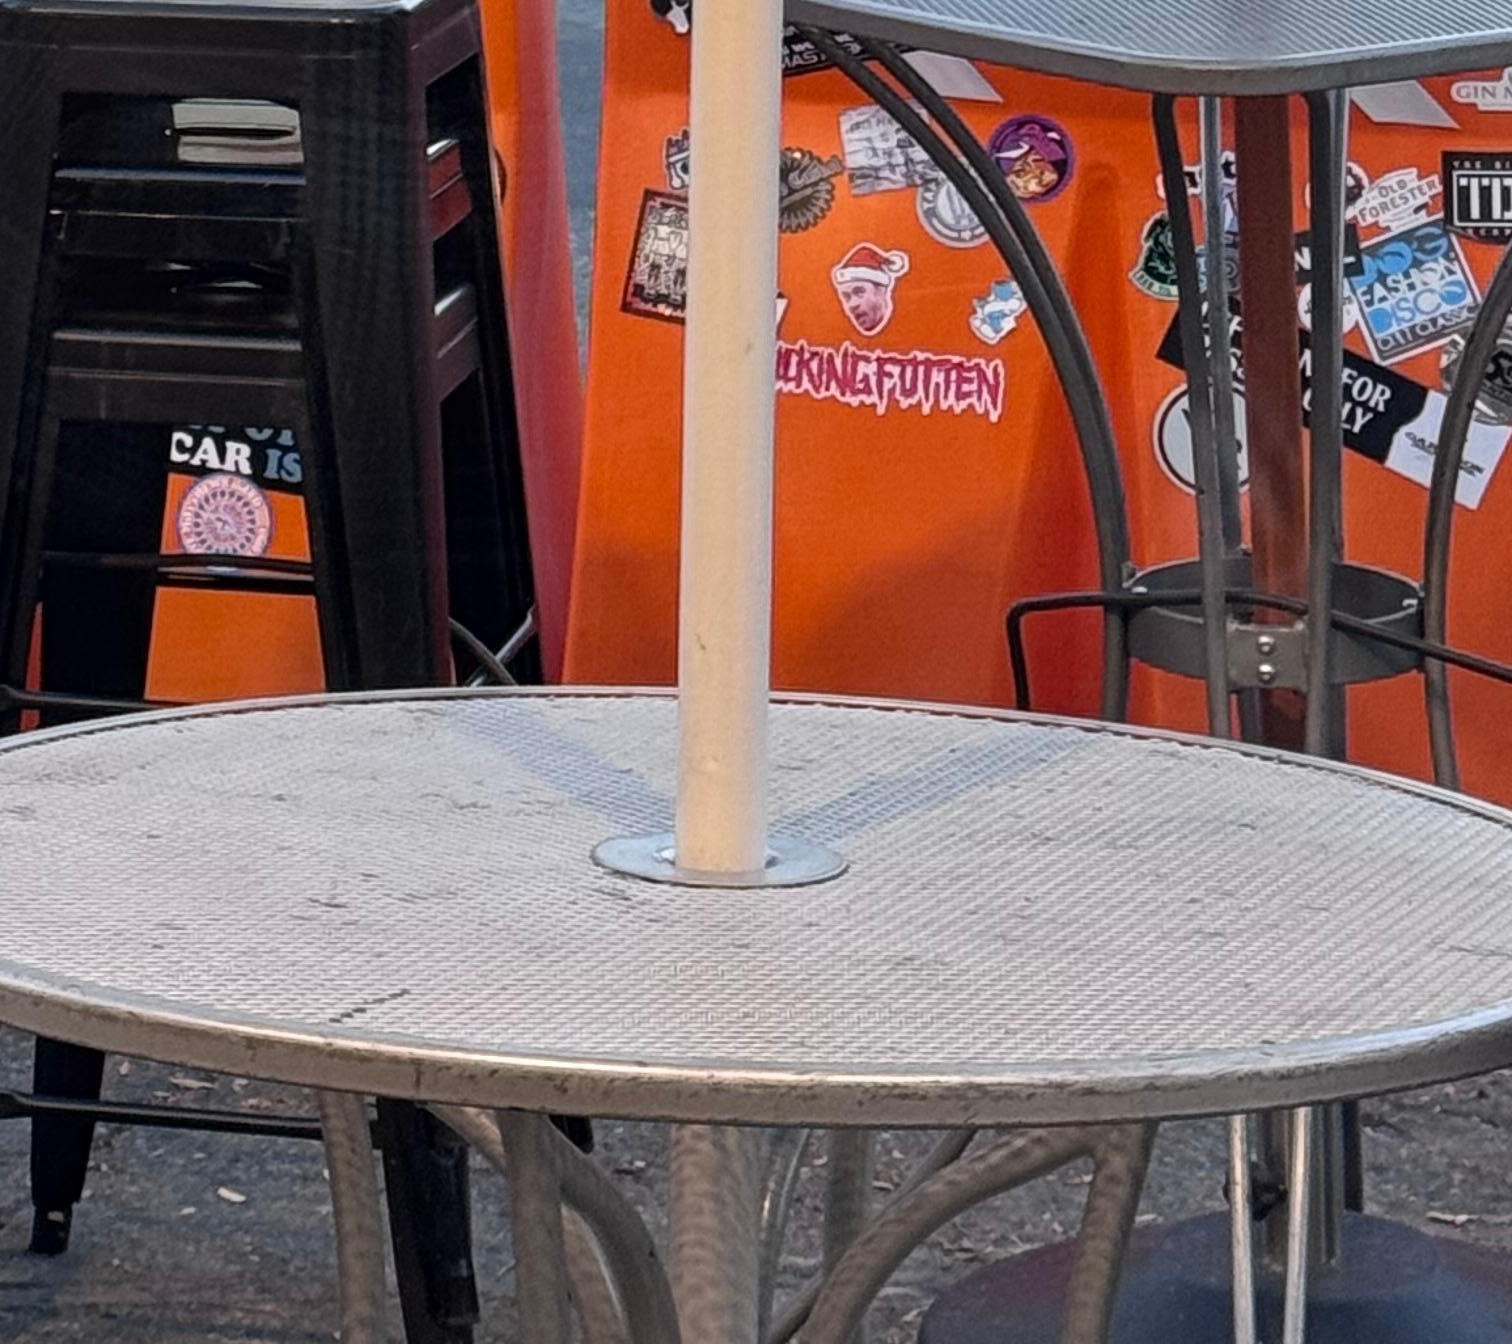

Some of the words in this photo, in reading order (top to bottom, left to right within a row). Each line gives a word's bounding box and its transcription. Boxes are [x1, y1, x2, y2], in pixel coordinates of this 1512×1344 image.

[1455, 84, 1497, 102] GIN
[1357, 178, 1439, 223] FORESTER
[1378, 178, 1409, 200] OLD
[1360, 258, 1459, 308] FASHION
[1367, 278, 1468, 335] DISCO
[1341, 367, 1392, 413] FOR
[170, 431, 253, 476] CAR
[263, 448, 304, 484] IS
